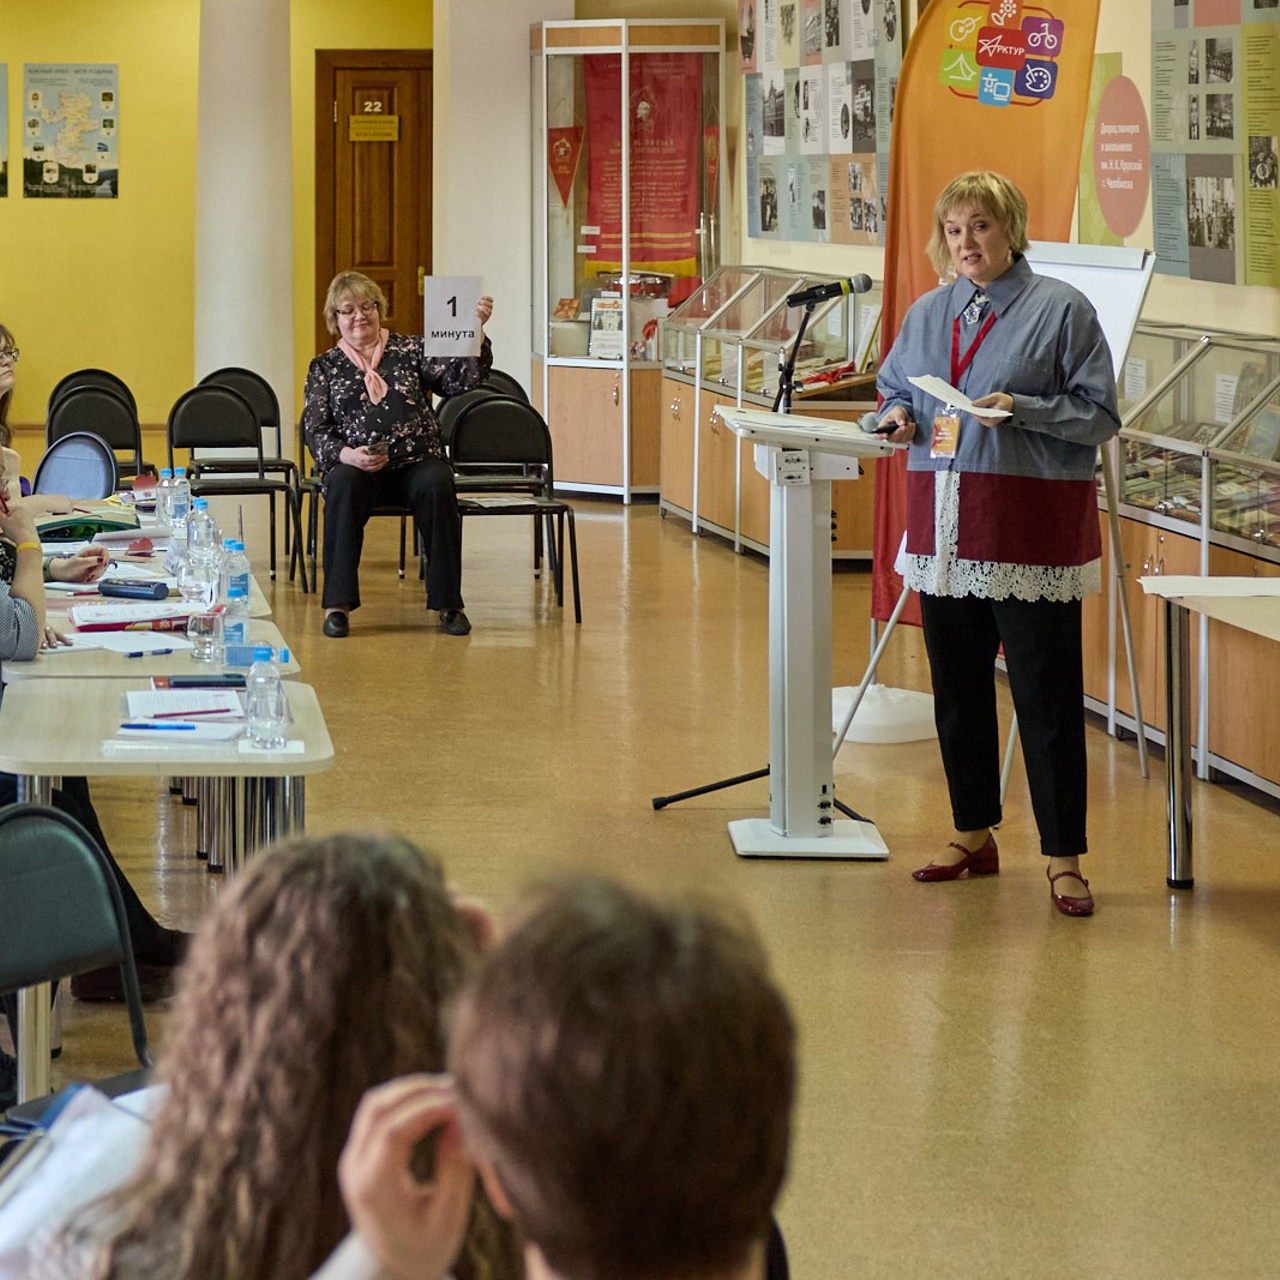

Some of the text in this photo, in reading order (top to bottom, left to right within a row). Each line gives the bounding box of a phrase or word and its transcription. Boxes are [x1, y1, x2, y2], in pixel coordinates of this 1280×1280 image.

[364, 101, 383, 113] 22
[446, 296, 457, 318] 1
[431, 330, 475, 341] минута
